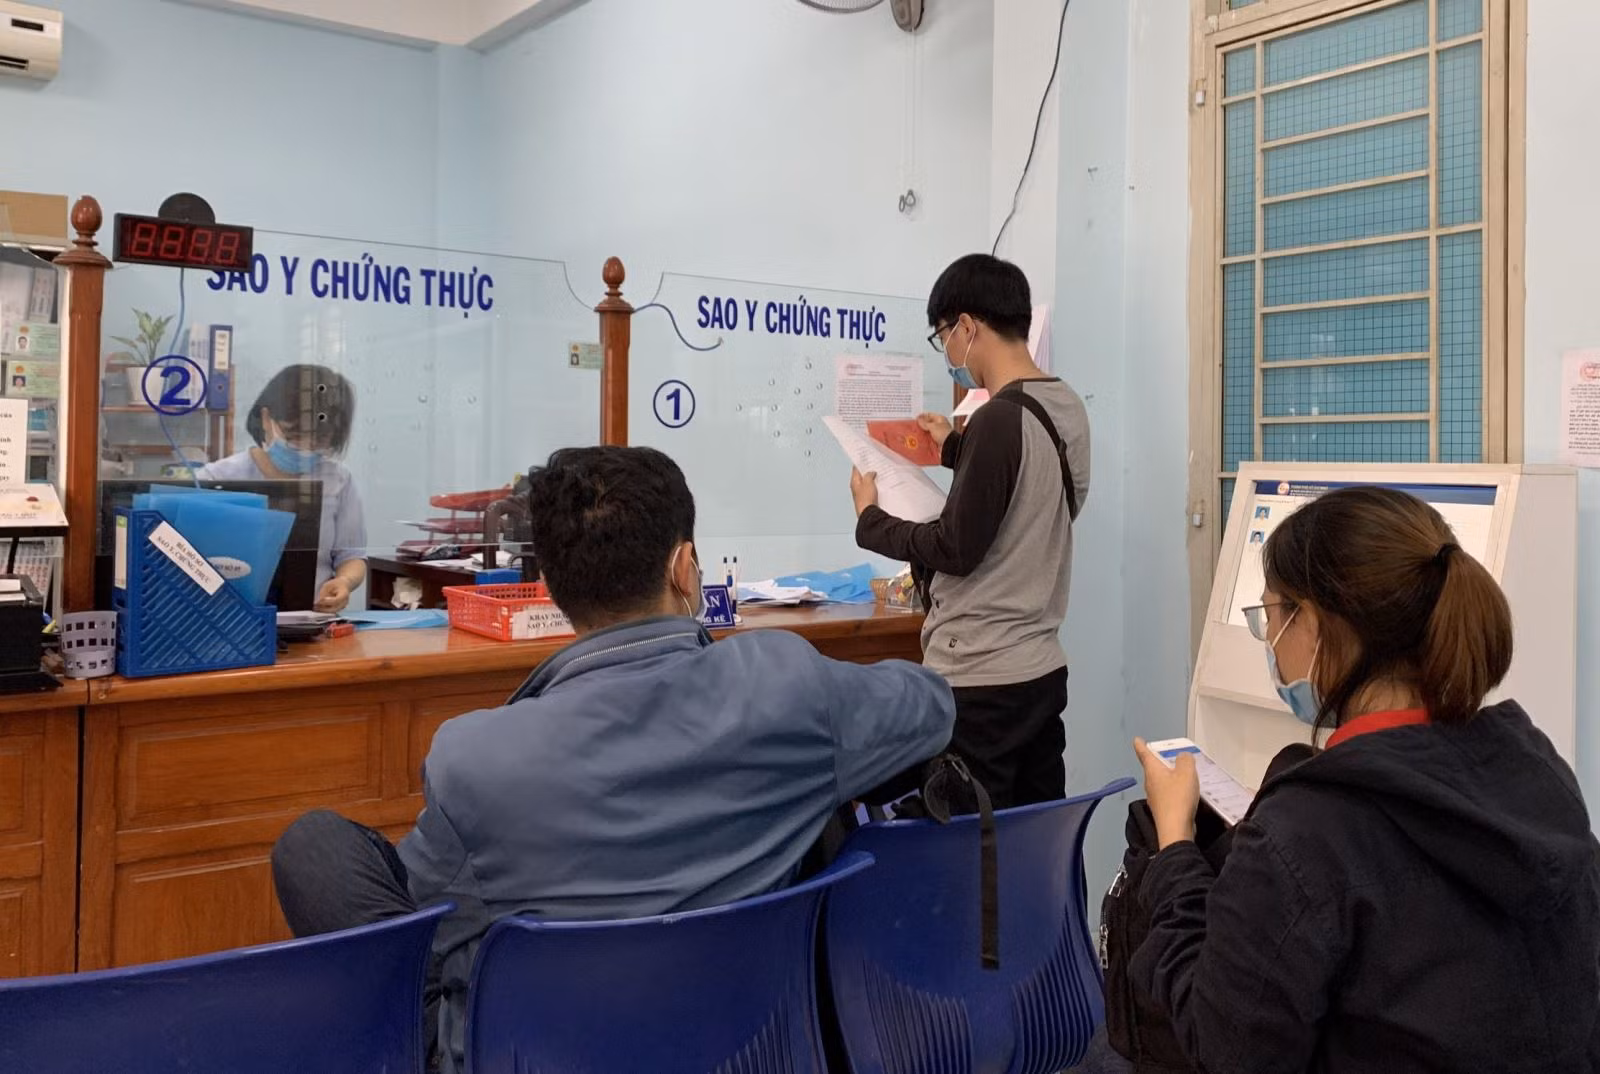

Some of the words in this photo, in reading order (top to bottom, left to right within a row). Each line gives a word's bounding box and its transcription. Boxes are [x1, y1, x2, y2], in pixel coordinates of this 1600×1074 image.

[280, 256, 299, 295] Y
[310, 253, 411, 304] CHỨNG
[420, 266, 493, 318] THỰC
[697, 296, 738, 329] SAO
[745, 299, 758, 331] Y
[765, 295, 831, 337] CHỨNG
[837, 306, 886, 348] THỰC
[160, 366, 191, 406] 2
[665, 388, 681, 421] 1
